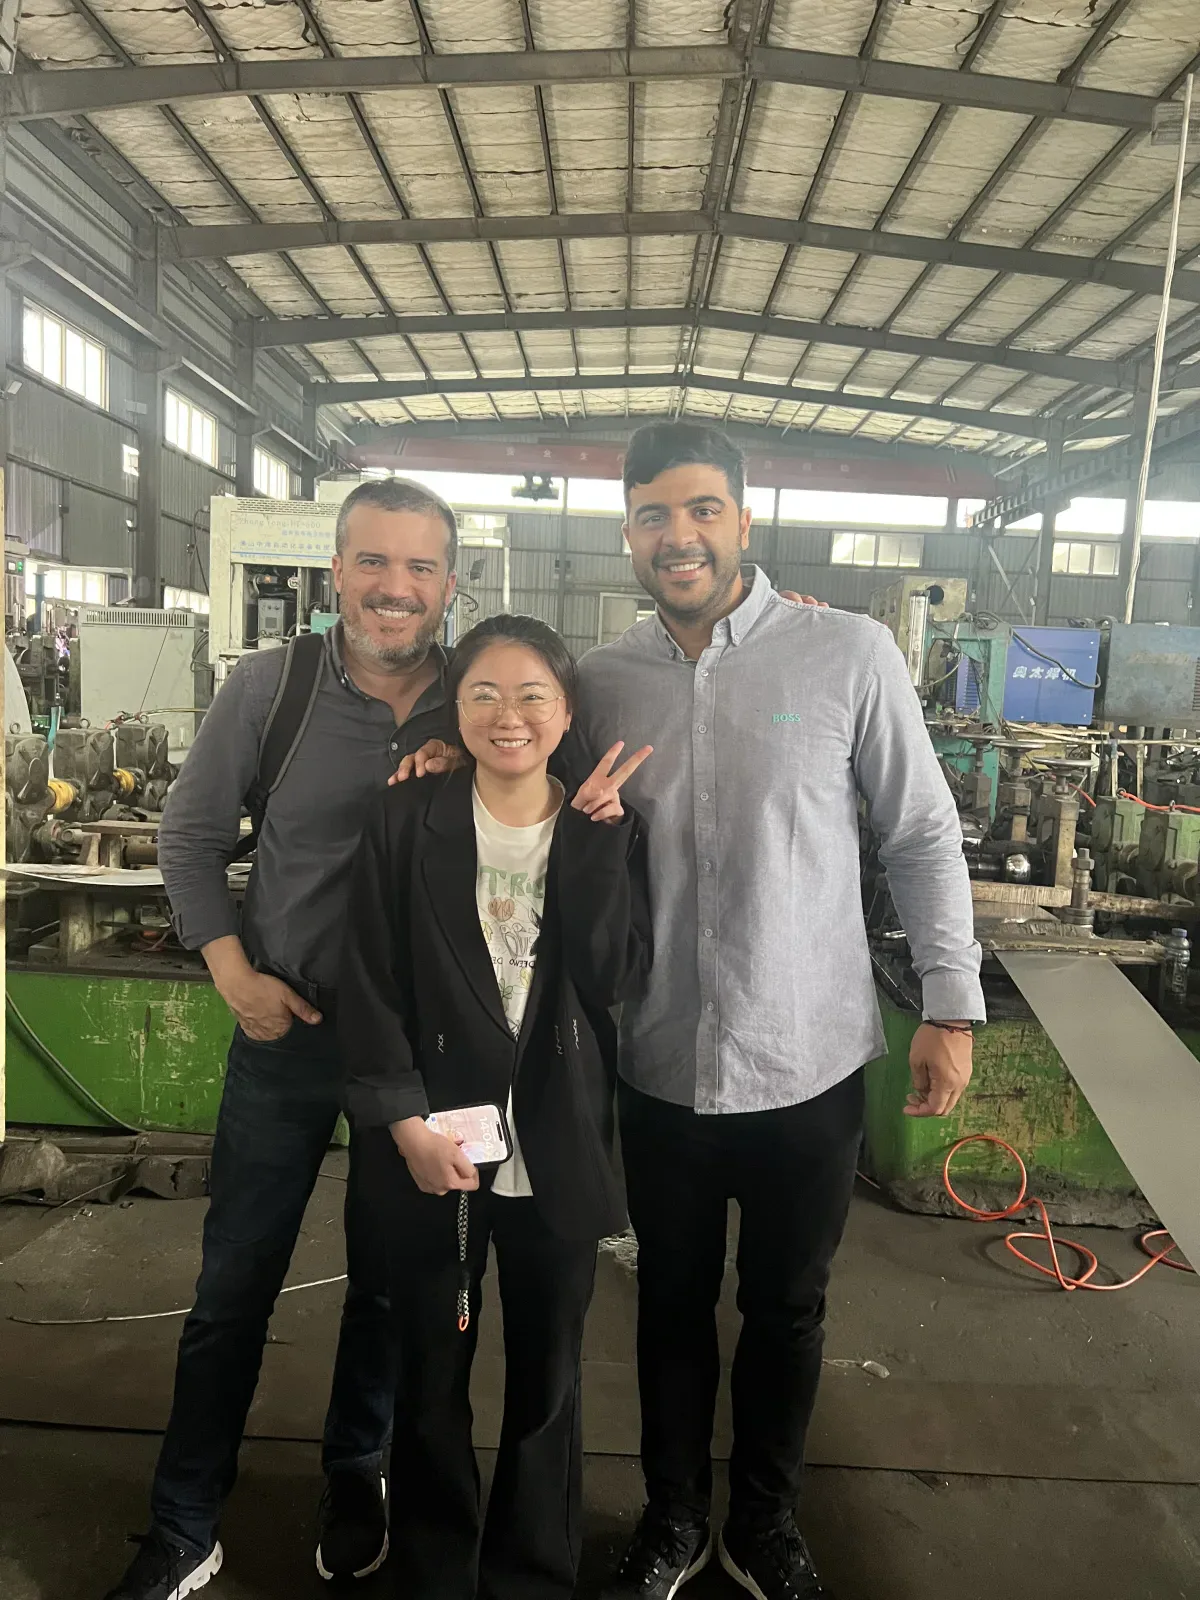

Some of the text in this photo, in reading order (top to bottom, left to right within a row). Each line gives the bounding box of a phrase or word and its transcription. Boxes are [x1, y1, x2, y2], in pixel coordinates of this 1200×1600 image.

[1012, 665, 1077, 682] 奥太焊机
[772, 713, 801, 724] BOSS
[480, 1116, 494, 1149] 14:04
